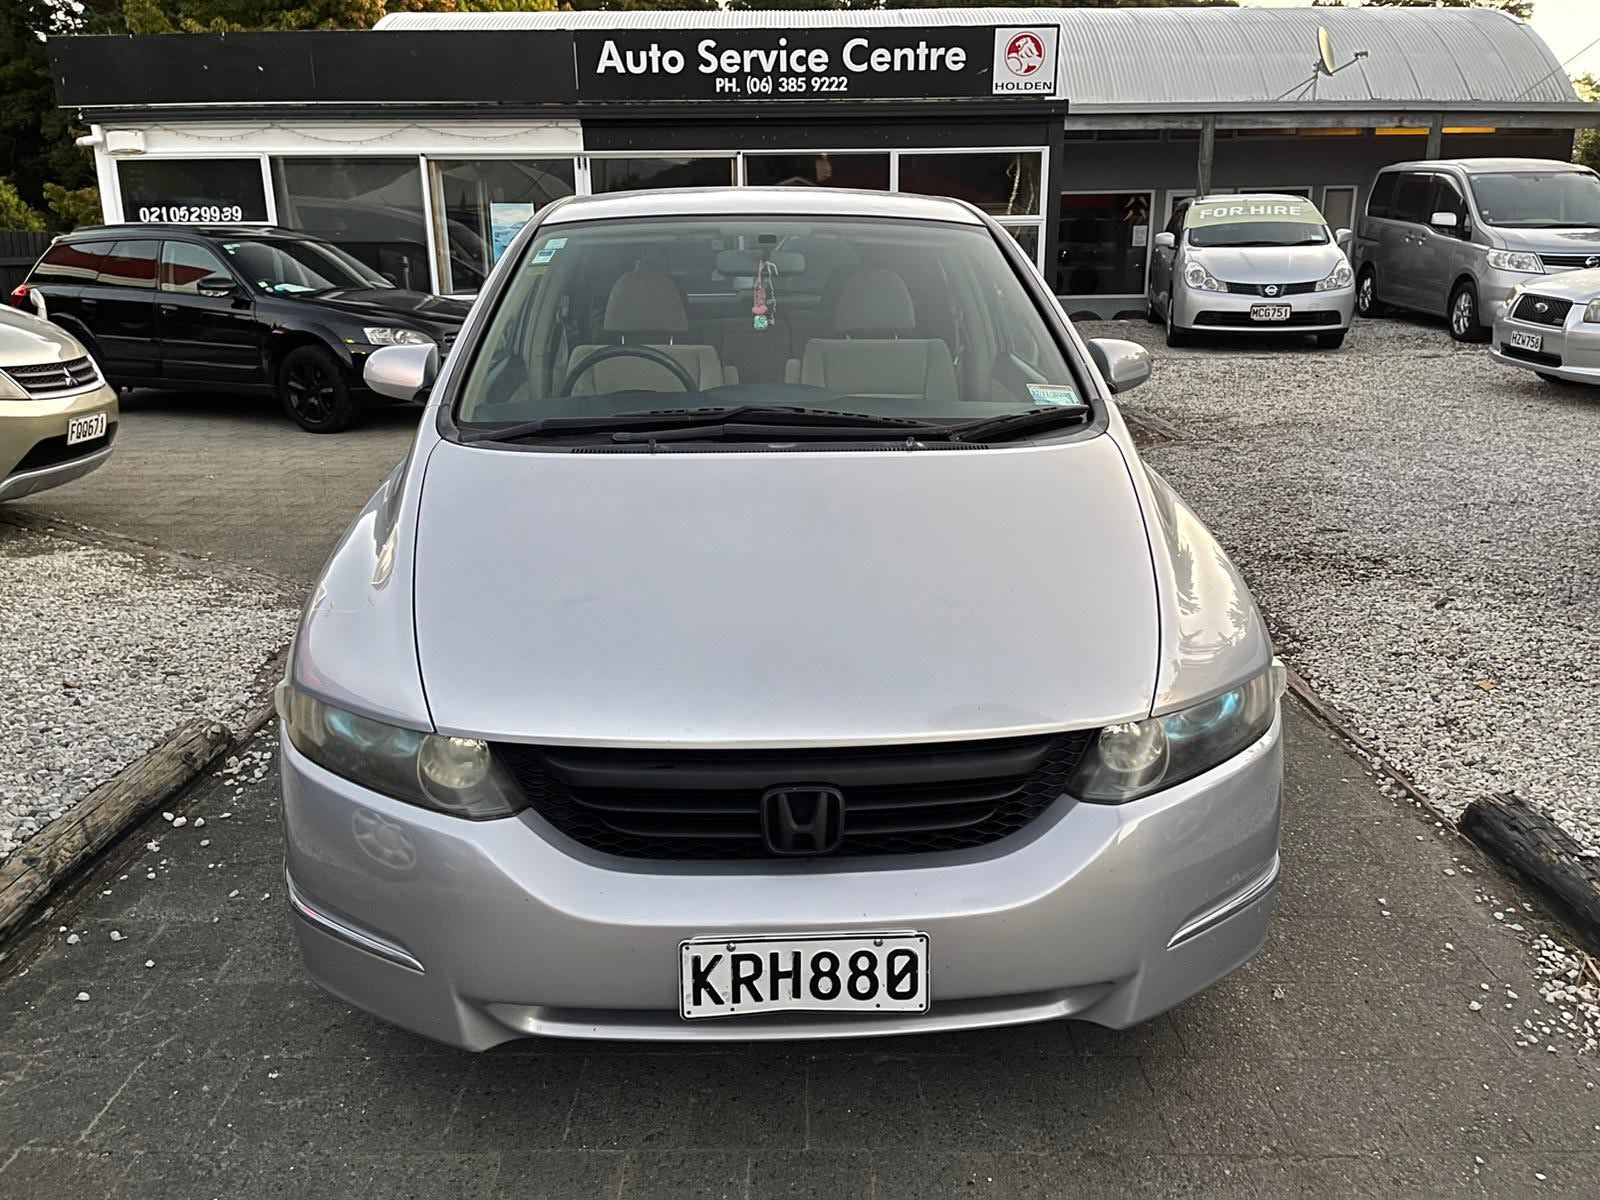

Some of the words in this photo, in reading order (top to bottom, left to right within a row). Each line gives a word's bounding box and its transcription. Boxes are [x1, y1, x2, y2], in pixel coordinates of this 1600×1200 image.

[596, 40, 685, 74] Auto
[697, 37, 829, 74] Service
[842, 37, 967, 72] Centre
[715, 77, 741, 93] PH.
[746, 75, 773, 94] (06)
[778, 77, 807, 93] 385
[811, 76, 848, 92] 9222
[995, 81, 1053, 91] HOLDEN
[139, 205, 243, 223] 0210529939
[1199, 206, 1242, 219] FOR
[1250, 205, 1302, 216] HIRE
[1251, 307, 1288, 318] MCG751
[691, 948, 919, 1007] KRH880
